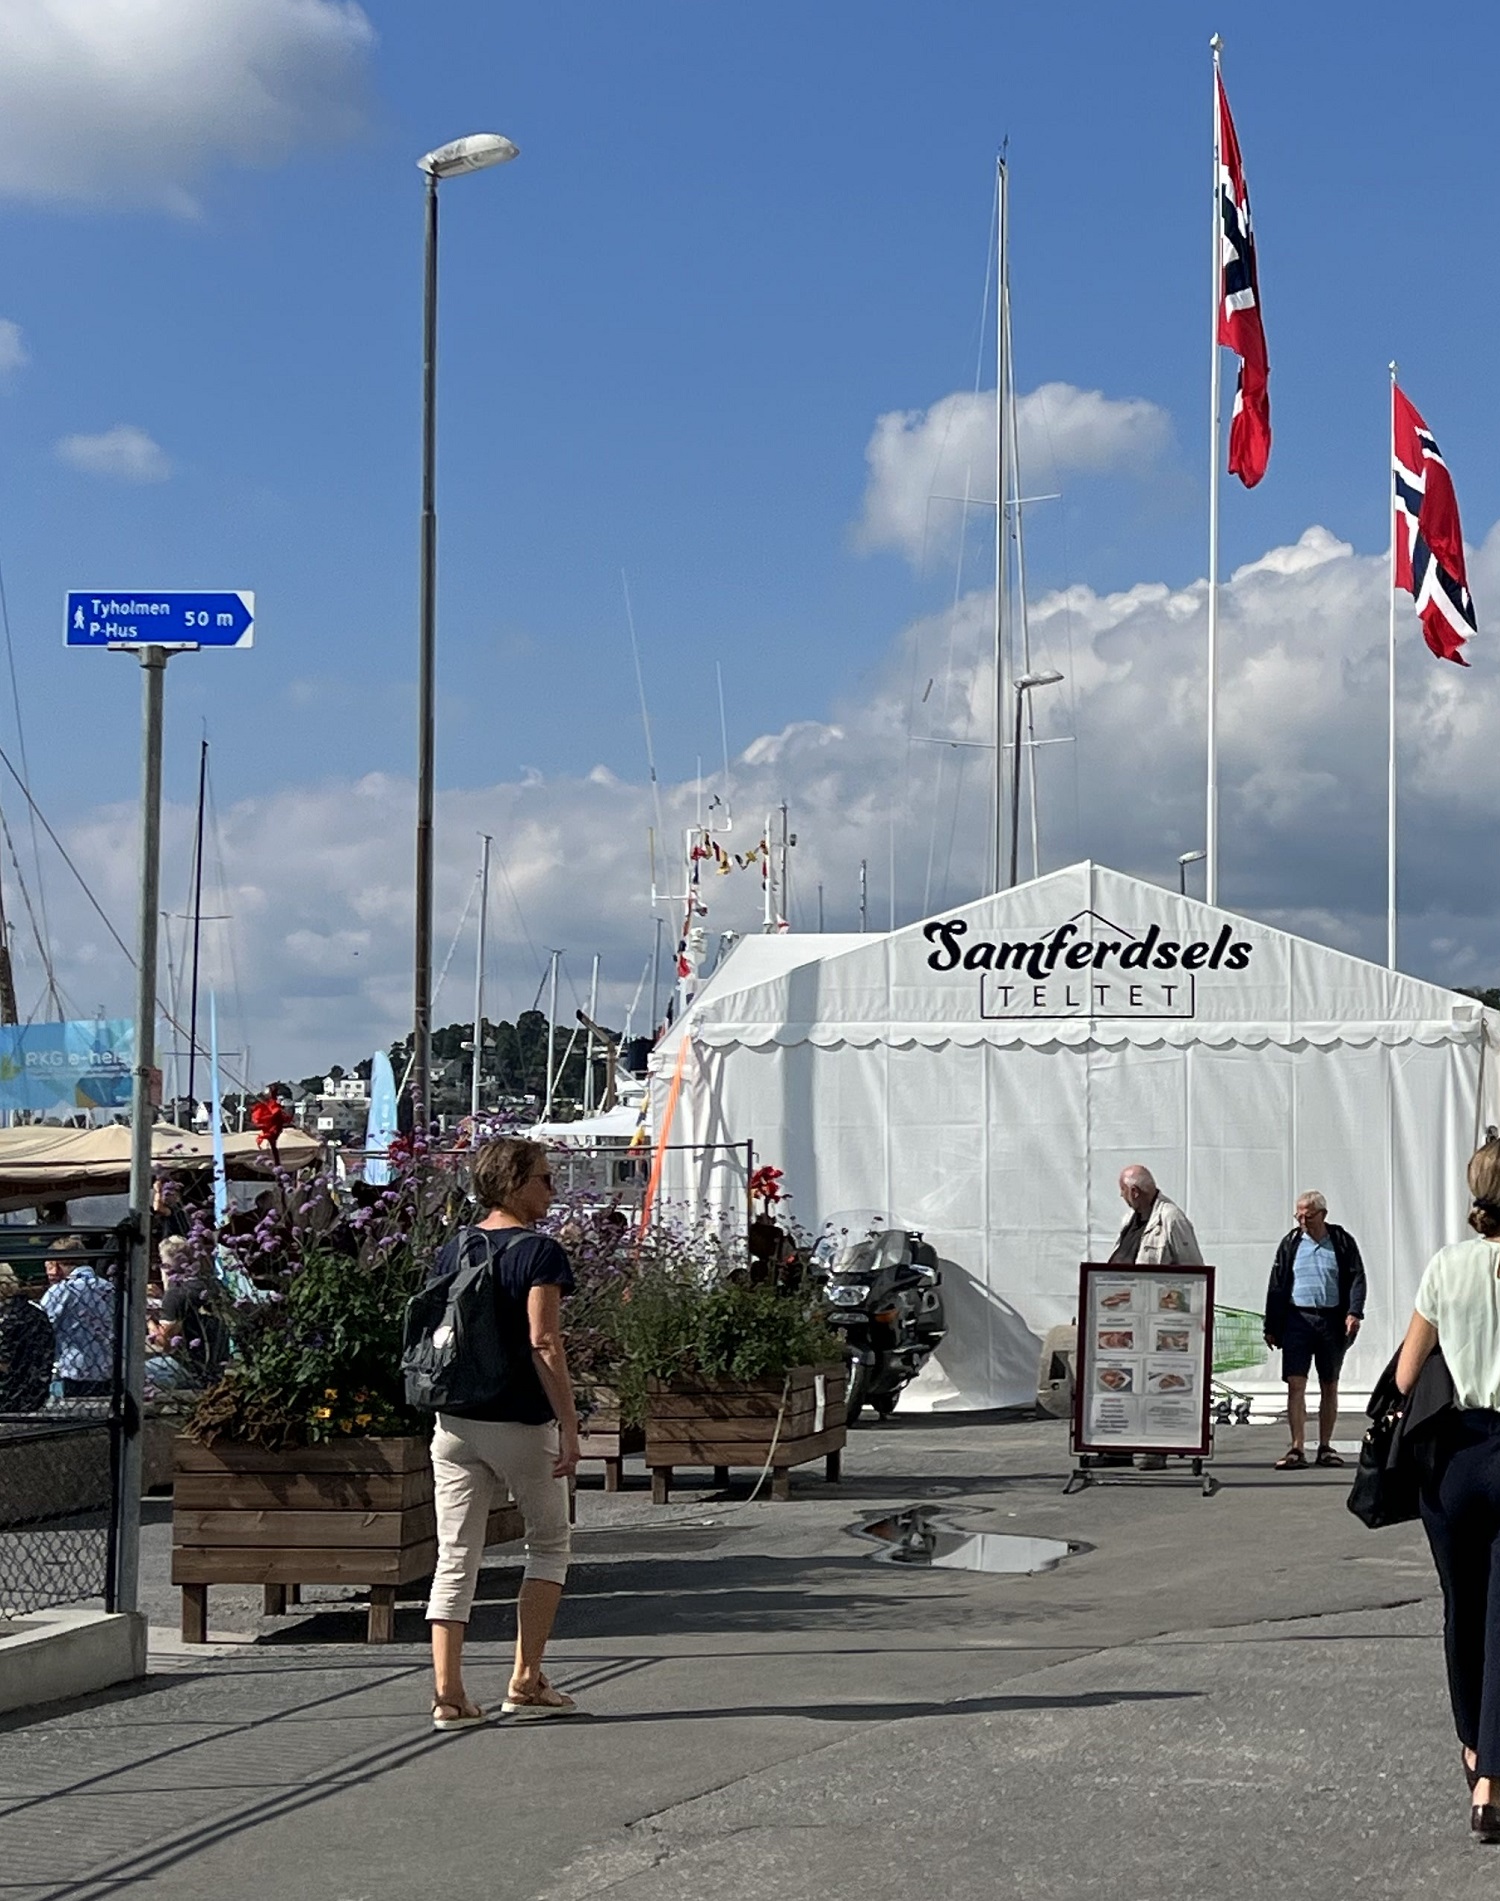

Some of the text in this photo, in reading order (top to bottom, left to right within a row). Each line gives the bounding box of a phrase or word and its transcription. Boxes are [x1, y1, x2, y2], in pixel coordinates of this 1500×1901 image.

[91, 599, 170, 618] Tyholmen
[184, 611, 233, 627] 50 m
[89, 622, 138, 638] P-Hus
[923, 919, 1253, 980] Samferdsels
[998, 985, 1179, 1008] TELTET
[25, 1051, 64, 1066] RKG
